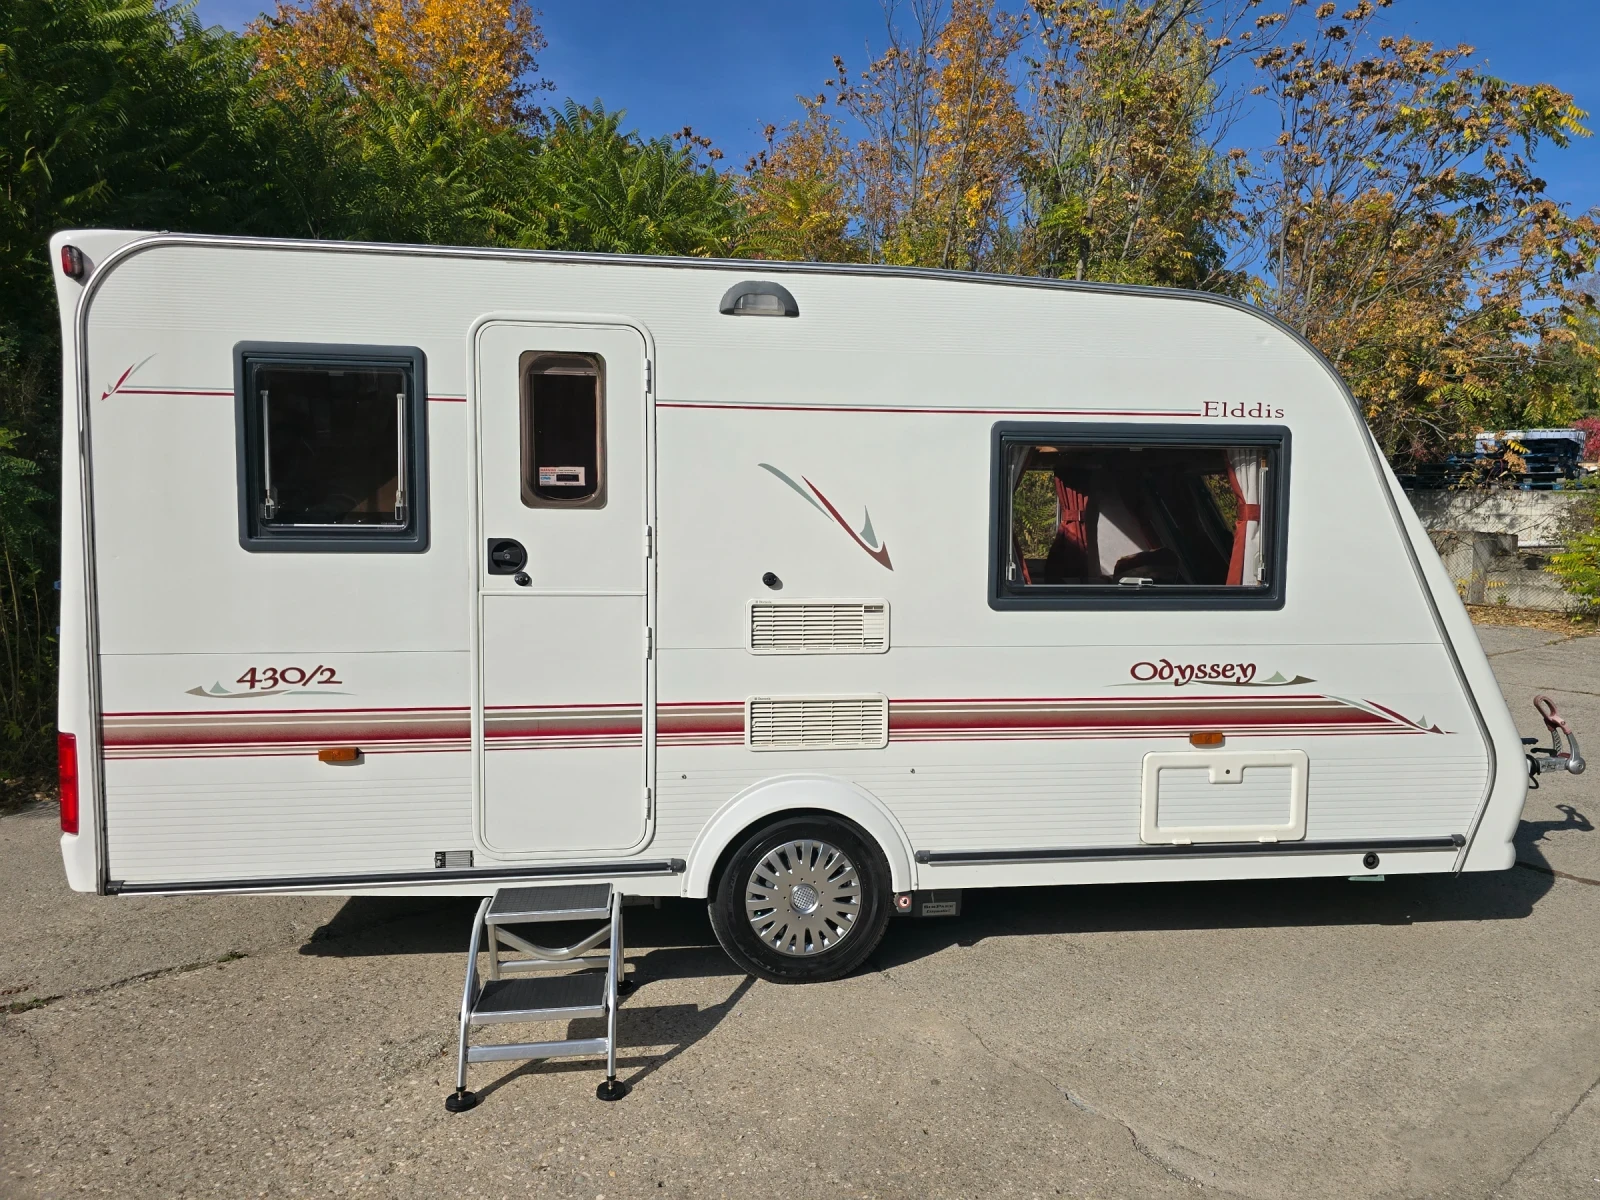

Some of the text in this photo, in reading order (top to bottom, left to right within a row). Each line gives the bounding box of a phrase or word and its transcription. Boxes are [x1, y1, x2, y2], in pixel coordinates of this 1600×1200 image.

[1203, 401, 1284, 418] Elddis
[236, 665, 342, 689] 430/2
[1130, 659, 1256, 686] Odyssey
